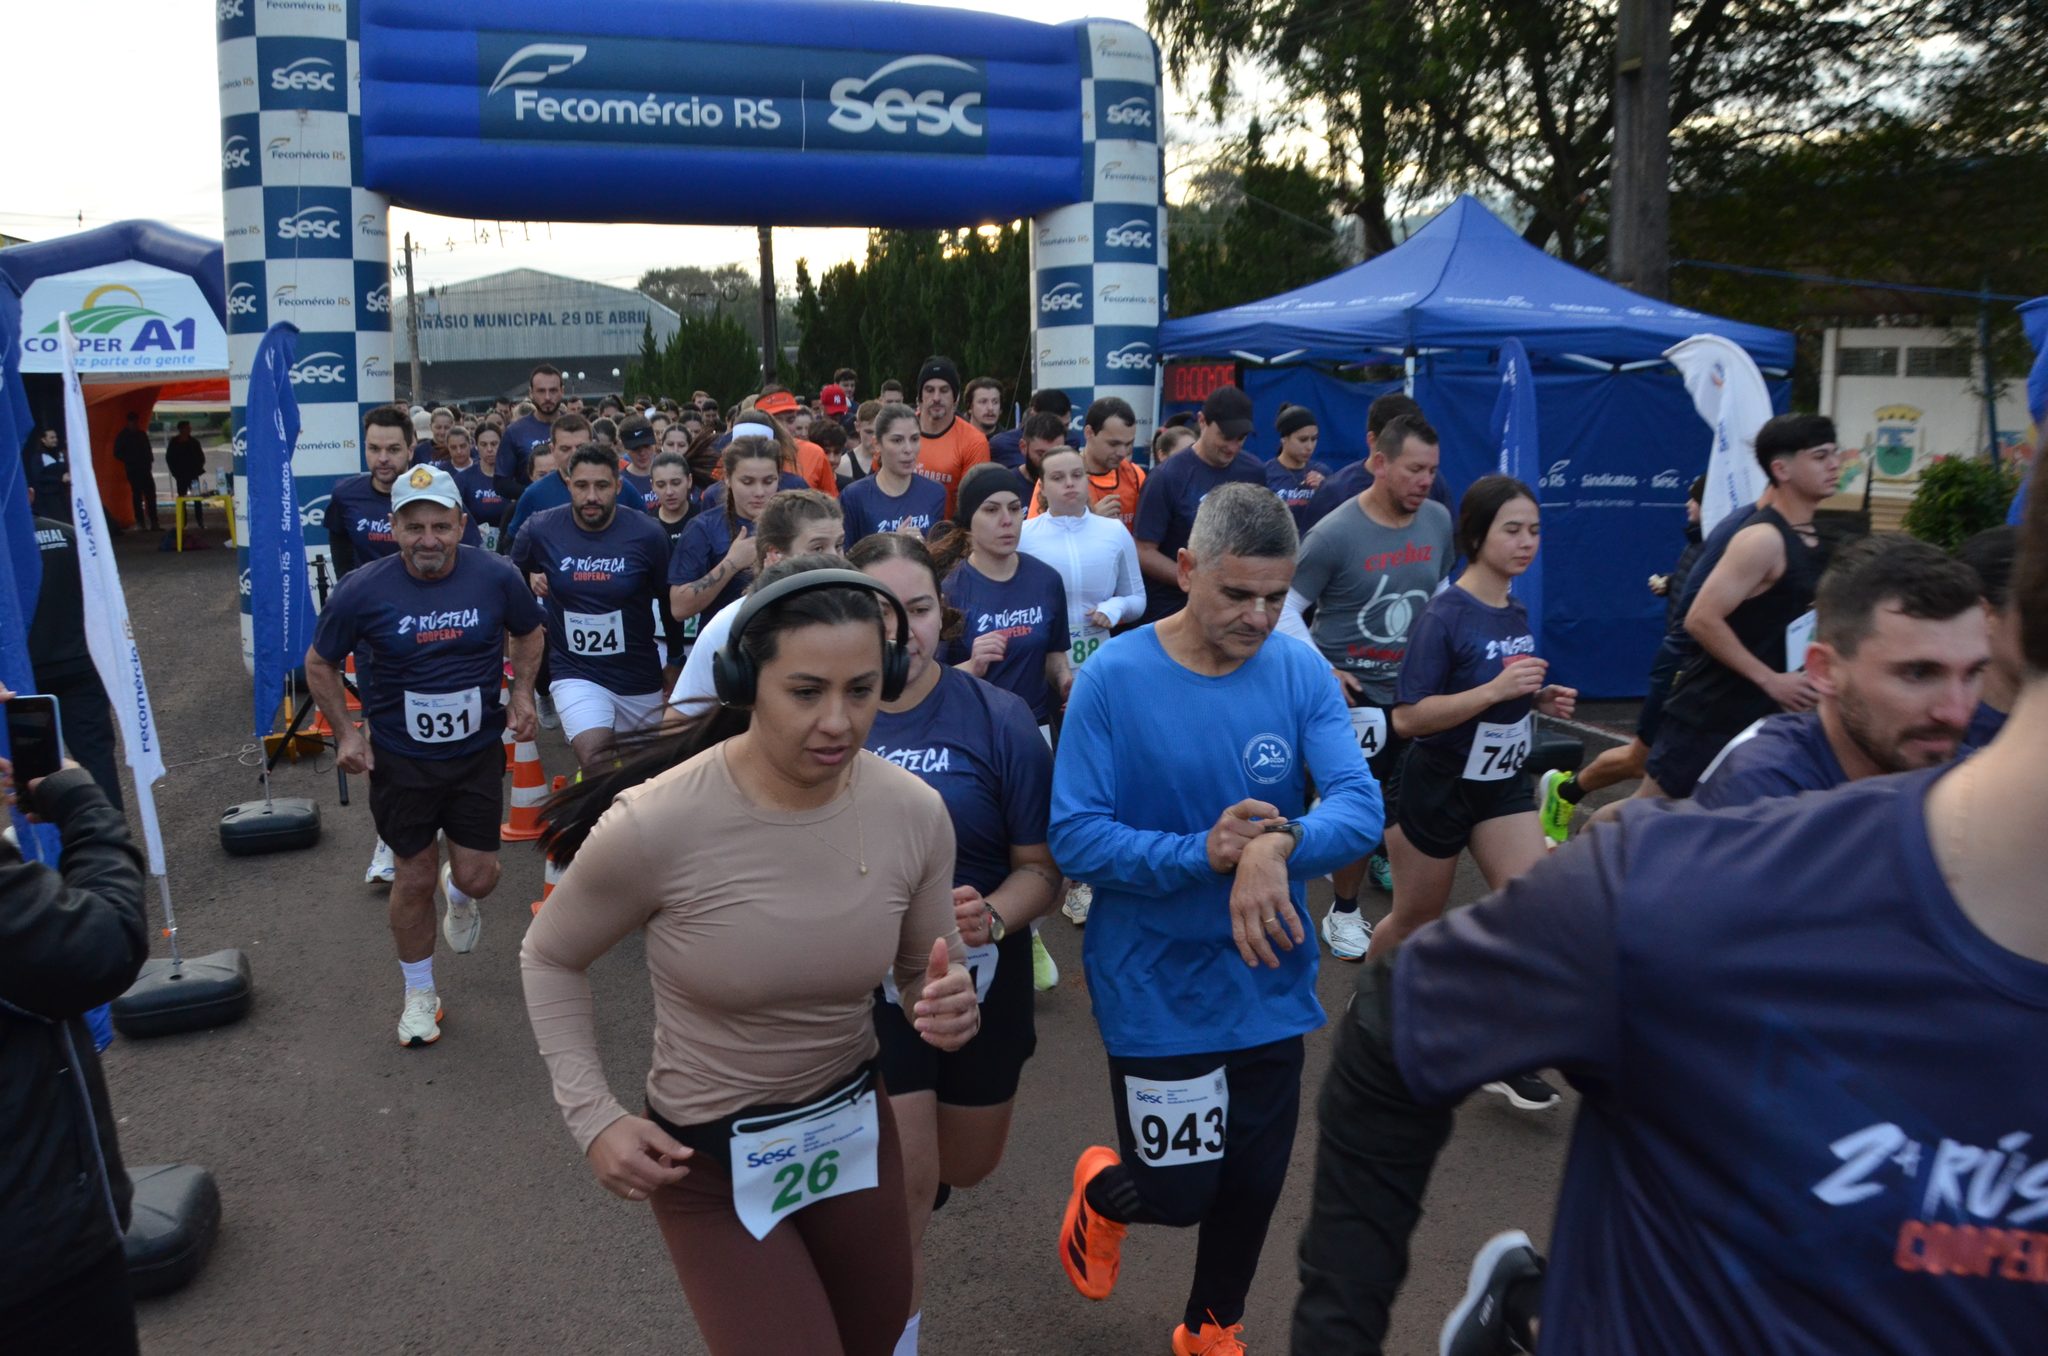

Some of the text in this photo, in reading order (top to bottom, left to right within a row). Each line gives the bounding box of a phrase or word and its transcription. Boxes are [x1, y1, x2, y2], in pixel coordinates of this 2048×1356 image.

[271, 67, 336, 92] Sesc
[514, 77, 983, 137] Fecomércio RS Sesc
[1106, 103, 1152, 127] Sesc
[272, 150, 330, 161] Fecomércio
[277, 217, 341, 239] Sesc
[1105, 227, 1152, 249] Sesc
[278, 298, 335, 307] Fecomércio
[1041, 292, 1083, 312] Sesc
[473, 311, 557, 329] MUNICIPAL
[562, 311, 582, 325] 29
[585, 311, 605, 325] DE
[608, 310, 648, 324] ABRIL
[24, 317, 196, 353] COPER A1
[91, 353, 130, 369] parte
[155, 352, 196, 368] gente
[1105, 351, 1153, 370] Sesc
[287, 363, 346, 385] Sesc
[296, 440, 341, 450] comércio
[281, 461, 292, 532] Sindicatos
[281, 551, 291, 571] RS
[572, 628, 618, 652] 924
[416, 708, 470, 739] 931
[1480, 740, 1526, 776] 748
[1141, 1106, 1225, 1161] 943
[747, 1144, 797, 1169] Sesc
[771, 1149, 840, 1213] 26
